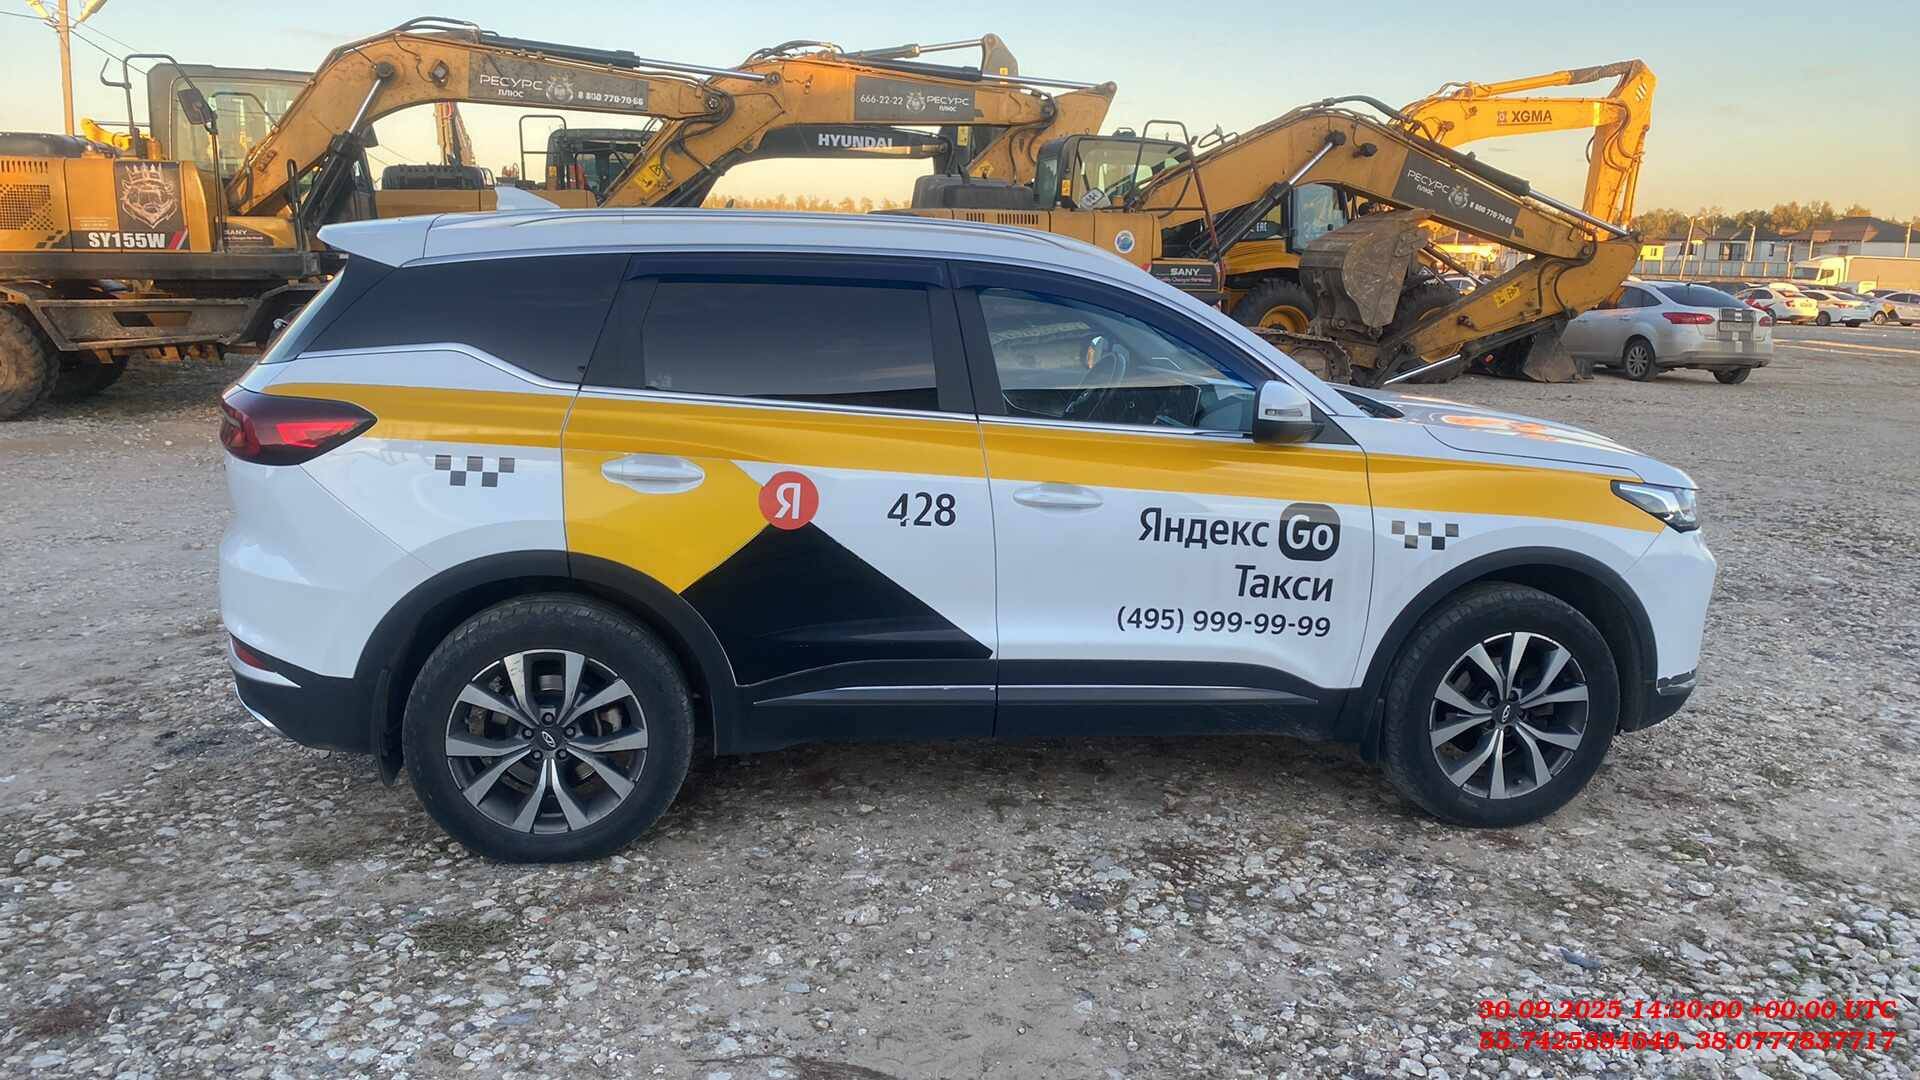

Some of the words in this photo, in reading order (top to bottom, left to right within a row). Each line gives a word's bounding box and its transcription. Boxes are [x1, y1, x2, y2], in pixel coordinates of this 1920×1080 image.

[479, 74, 543, 91] РЕСУРС
[860, 94, 904, 105] 666-22-22
[926, 95, 969, 106] РЕСУРС
[1511, 110, 1552, 122] XGMA
[818, 133, 893, 149] HYUNDAI
[1407, 169, 1450, 194] РЕСУРС
[88, 231, 165, 248] SY155W
[1170, 268, 1200, 276] SANY
[887, 491, 956, 527] 428
[1138, 507, 1270, 550] Яндекс
[1285, 514, 1335, 551] Go
[1234, 564, 1333, 602] Такси
[1116, 606, 1185, 634] (495)
[1192, 610, 1331, 637] 999-99-99
